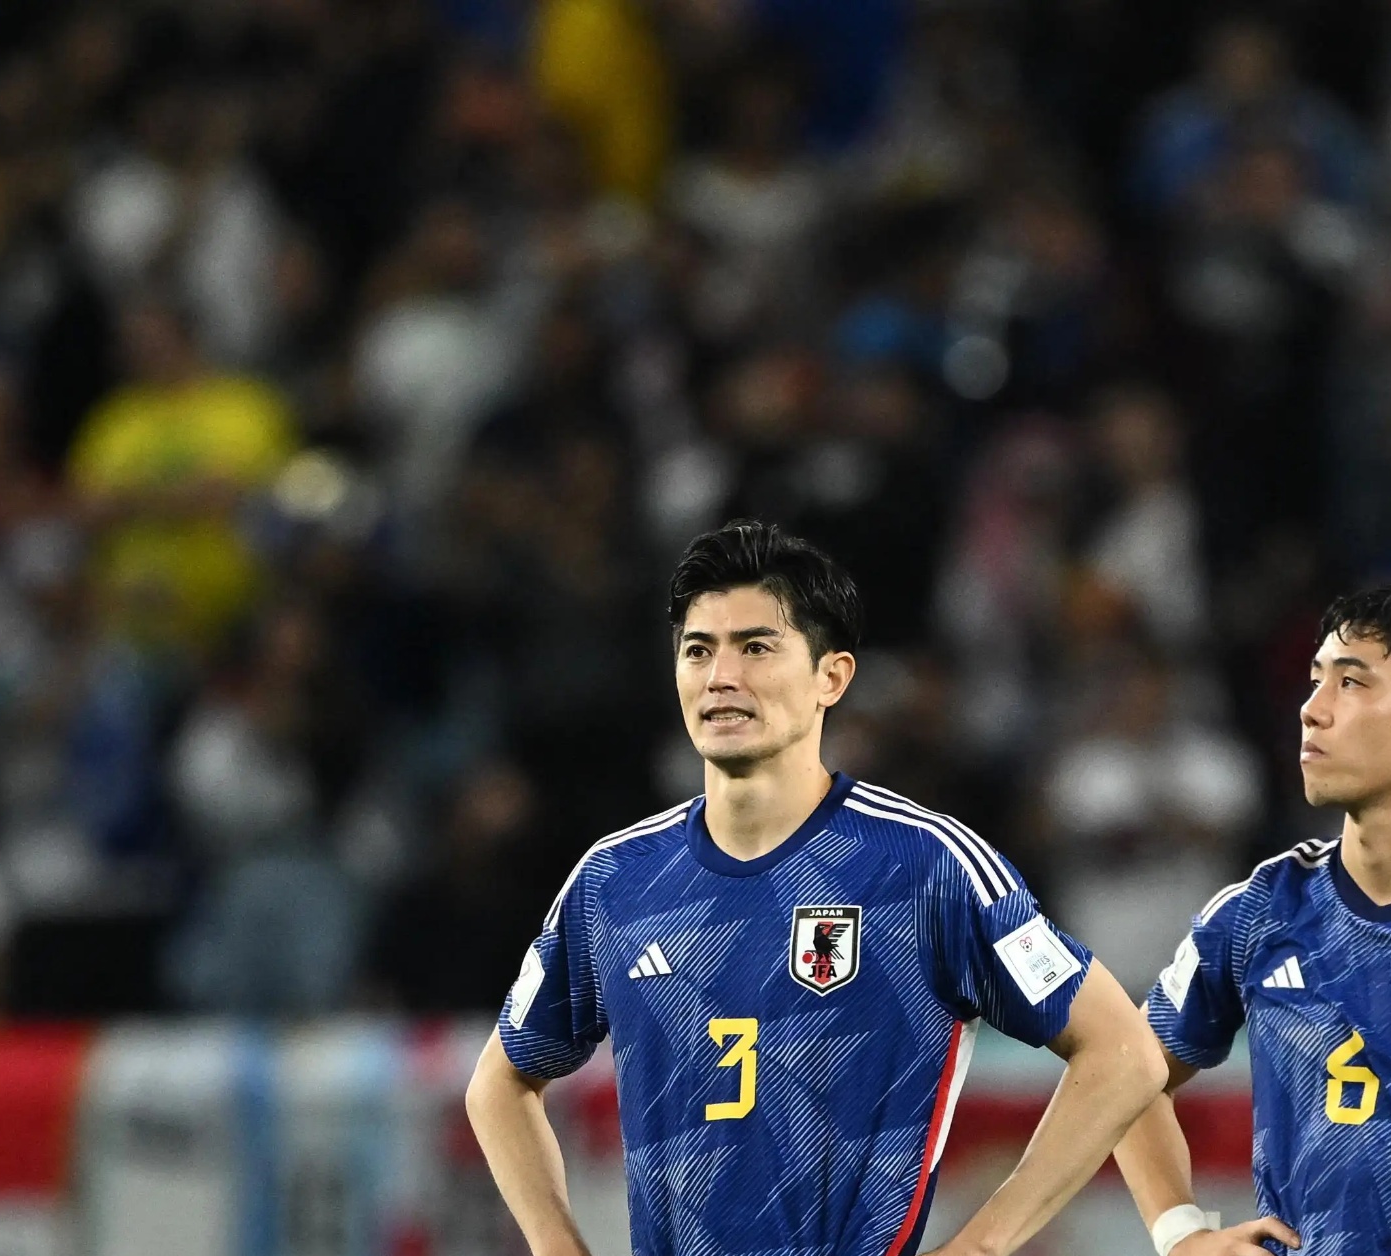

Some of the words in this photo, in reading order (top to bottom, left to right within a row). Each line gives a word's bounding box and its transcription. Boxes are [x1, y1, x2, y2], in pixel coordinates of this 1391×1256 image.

[808, 964, 837, 978] JFA
[705, 1017, 758, 1121] 3
[1325, 1030, 1380, 1125] 6
